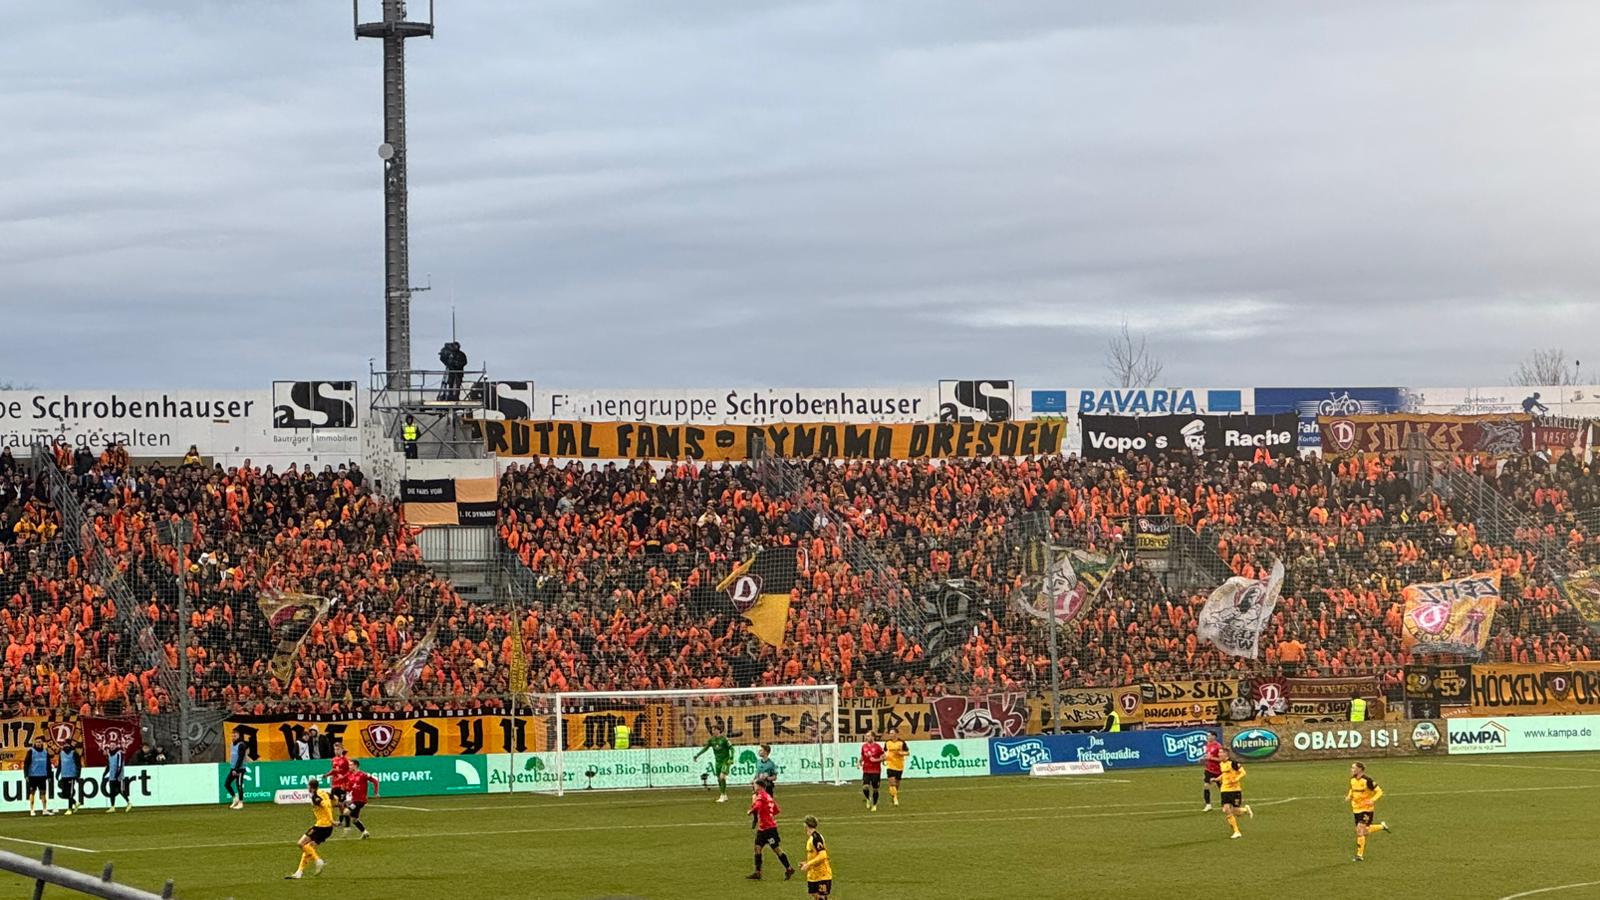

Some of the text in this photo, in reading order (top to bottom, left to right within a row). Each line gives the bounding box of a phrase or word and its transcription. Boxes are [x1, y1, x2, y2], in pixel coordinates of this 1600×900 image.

[32, 394, 253, 419] Schrobenhauser
[726, 391, 921, 416] Schrobenhauser
[1079, 390, 1197, 413] BAVARIA
[75, 428, 170, 451] gestalten
[617, 424, 706, 459] FANS
[746, 423, 893, 459] DYNAMO
[908, 421, 1060, 456] DRESDEN
[1225, 430, 1292, 447] Rache
[1366, 421, 1463, 452] SNAKES
[1441, 680, 1460, 696] 53
[1472, 671, 1548, 707] HÖCKEN
[1064, 709, 1102, 723] WEST
[1144, 708, 1187, 718] BRIGADE
[1294, 731, 1362, 750] OBAZD
[1371, 729, 1398, 747] IS!
[1450, 731, 1502, 744] KAMPA
[1524, 728, 1592, 739] www.kampa.de
[997, 743, 1040, 761] Bayern
[1088, 736, 1104, 750] Das
[1166, 735, 1207, 753] Bayern
[1233, 739, 1278, 748] Alpenhain
[800, 758, 822, 769] Das
[909, 757, 988, 775] Alpenbauer
[1020, 748, 1049, 767] Park
[402, 771, 433, 780] PART.
[588, 762, 689, 775] Das Bio-Bonbon
[280, 776, 298, 785] WE
[489, 768, 575, 788] Alpenbauer
